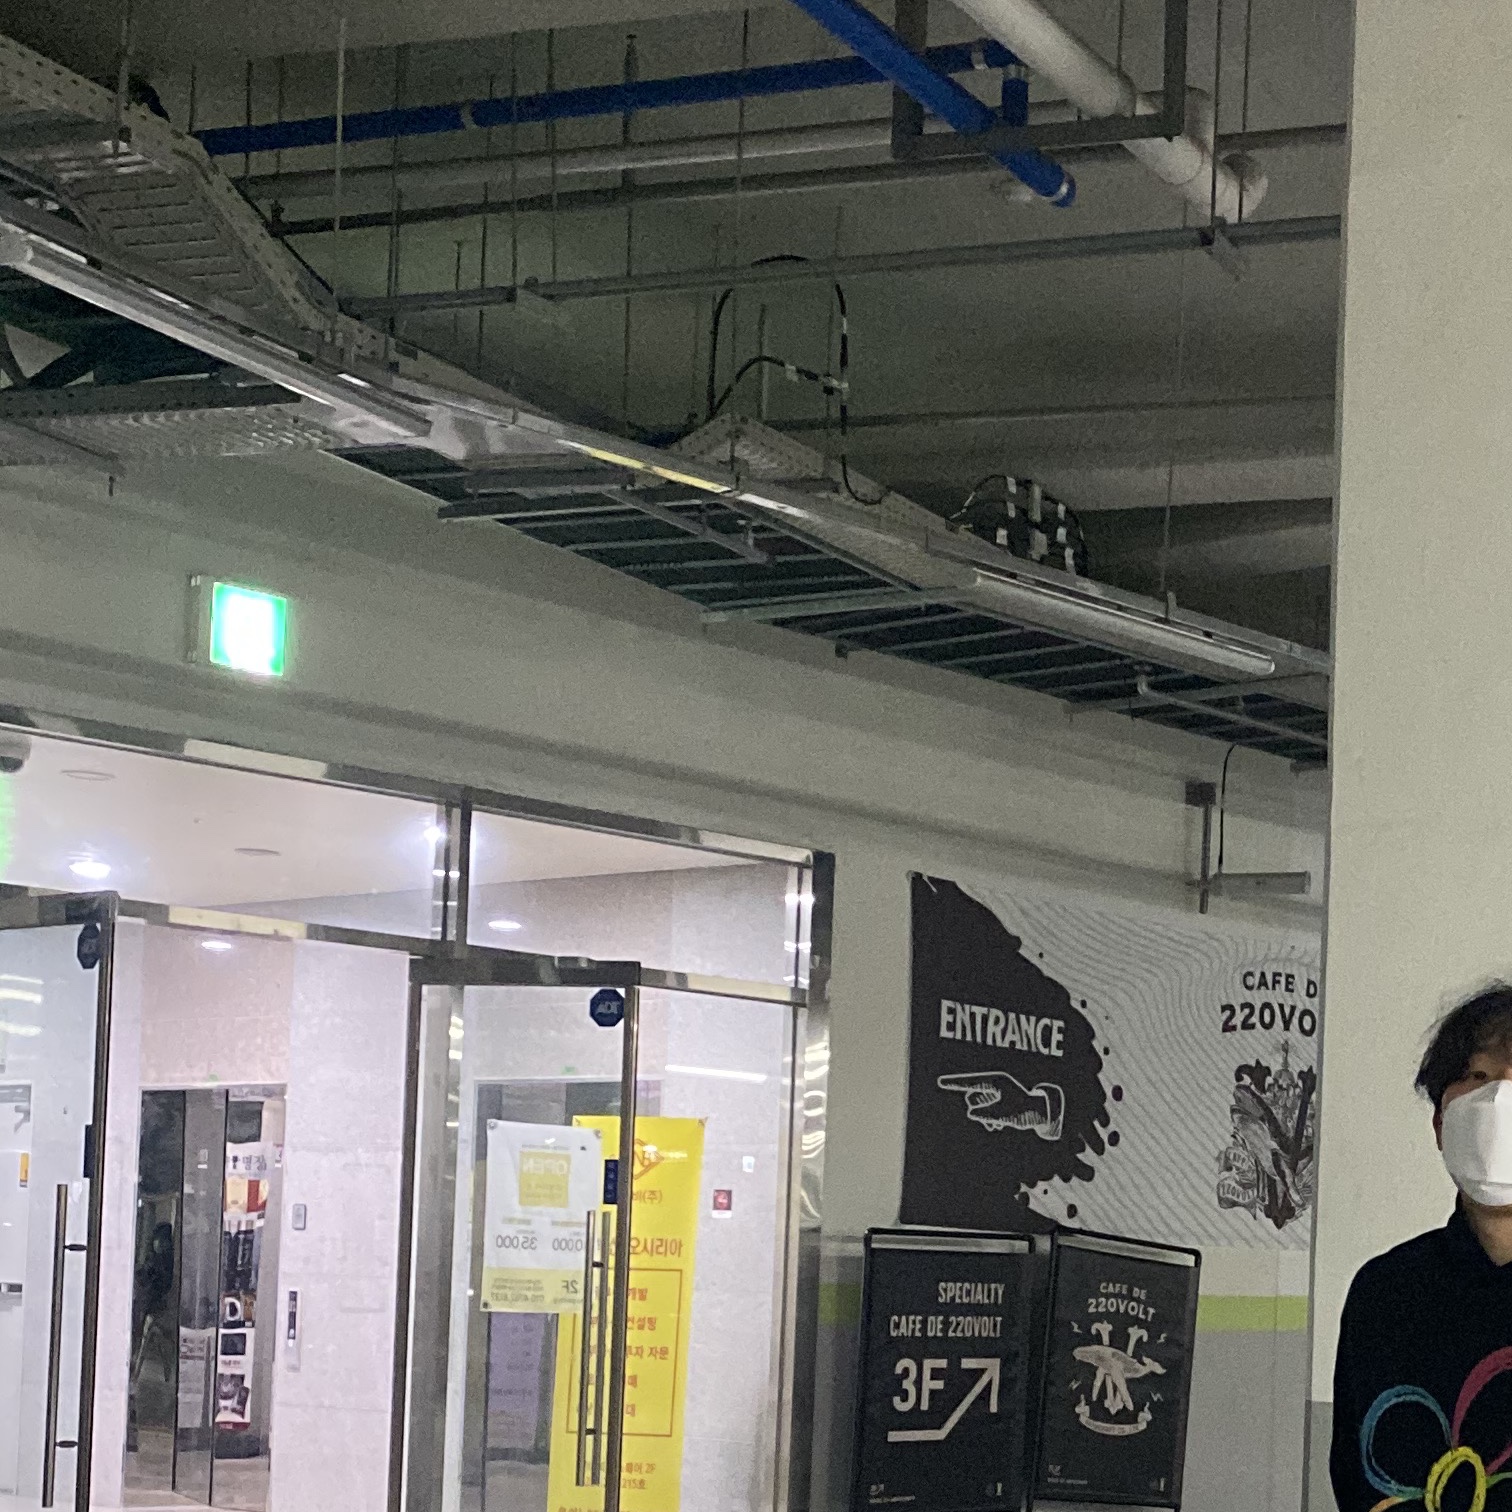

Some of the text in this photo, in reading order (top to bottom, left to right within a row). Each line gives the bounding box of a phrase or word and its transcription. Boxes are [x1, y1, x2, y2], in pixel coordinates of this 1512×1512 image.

[1242, 971, 1318, 999] CAFE D
[940, 999, 1065, 1057] ENTRANCE
[1220, 1002, 1317, 1037] 220VO
[938, 1282, 1005, 1304] SPECIALTY
[1100, 1282, 1148, 1300] CAFE DE
[1087, 1297, 1156, 1322] 220VOLT
[889, 1314, 1003, 1338] CAFE DE 220VOLT
[892, 1357, 948, 1412] 3F
